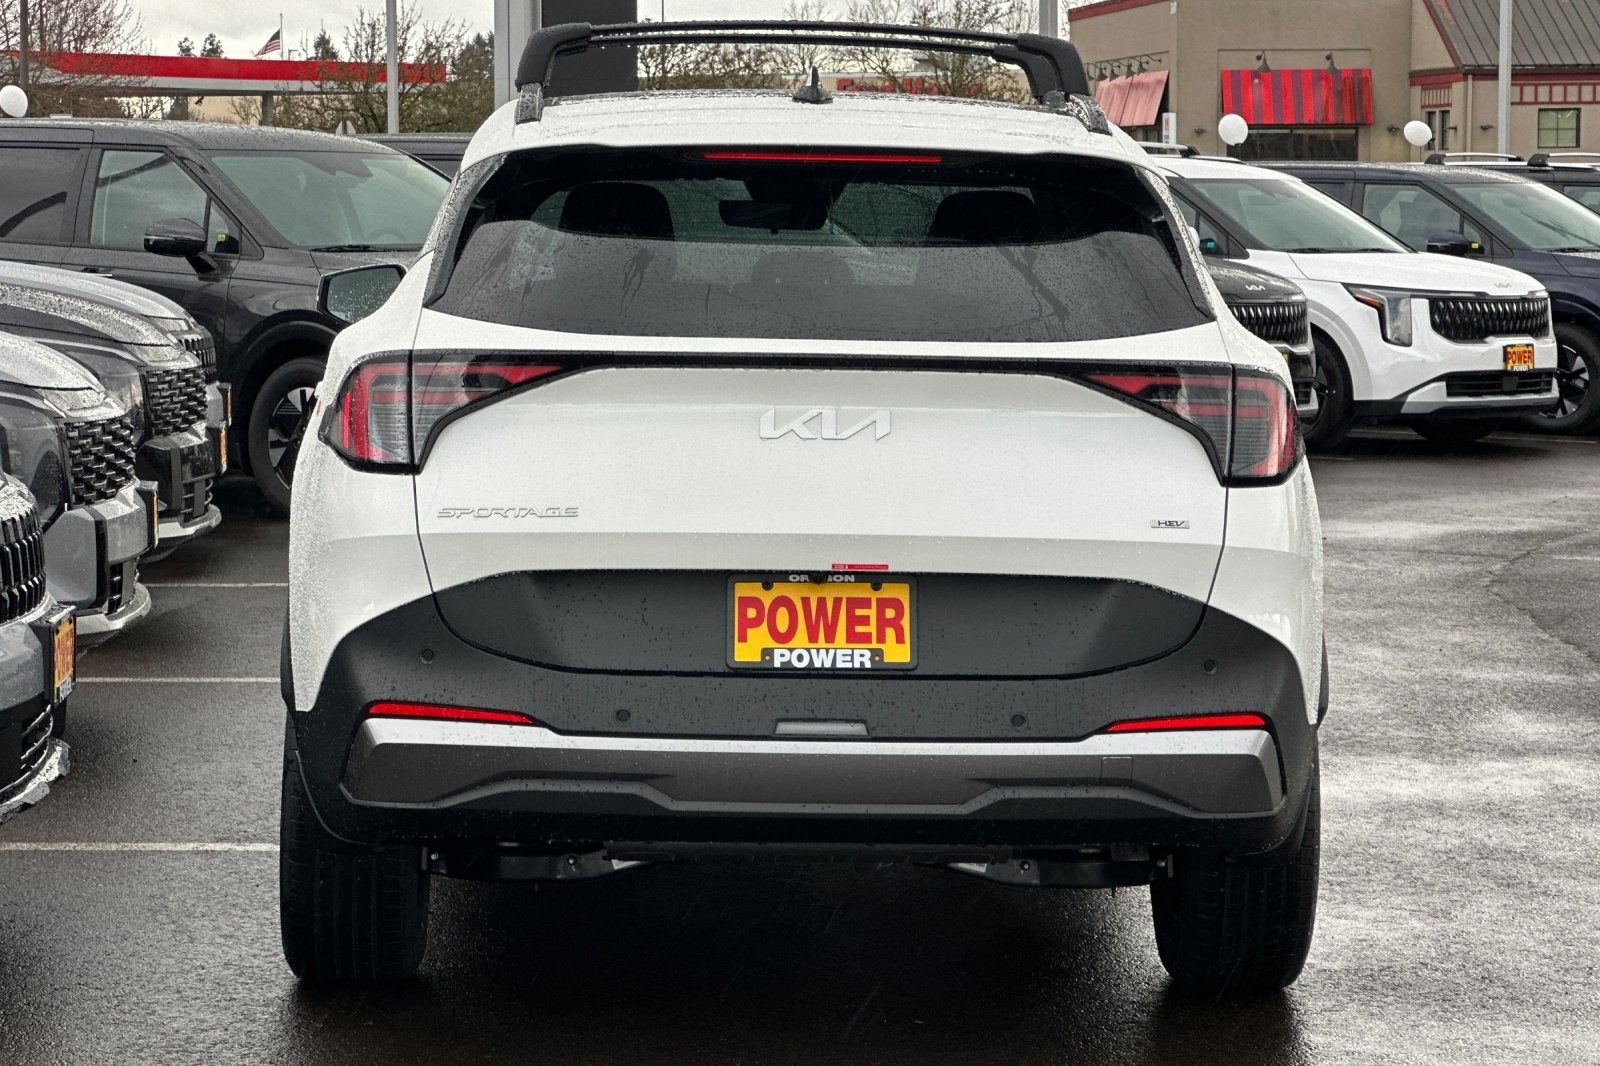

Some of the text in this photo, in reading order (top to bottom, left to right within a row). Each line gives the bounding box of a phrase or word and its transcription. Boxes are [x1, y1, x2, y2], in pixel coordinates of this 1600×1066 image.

[759, 407, 891, 441] KIA
[437, 507, 579, 519] SPORTAGE
[1157, 519, 1186, 527] HEV
[788, 574, 855, 582] ORON
[737, 595, 906, 645] POWER
[773, 648, 872, 669] POWER
